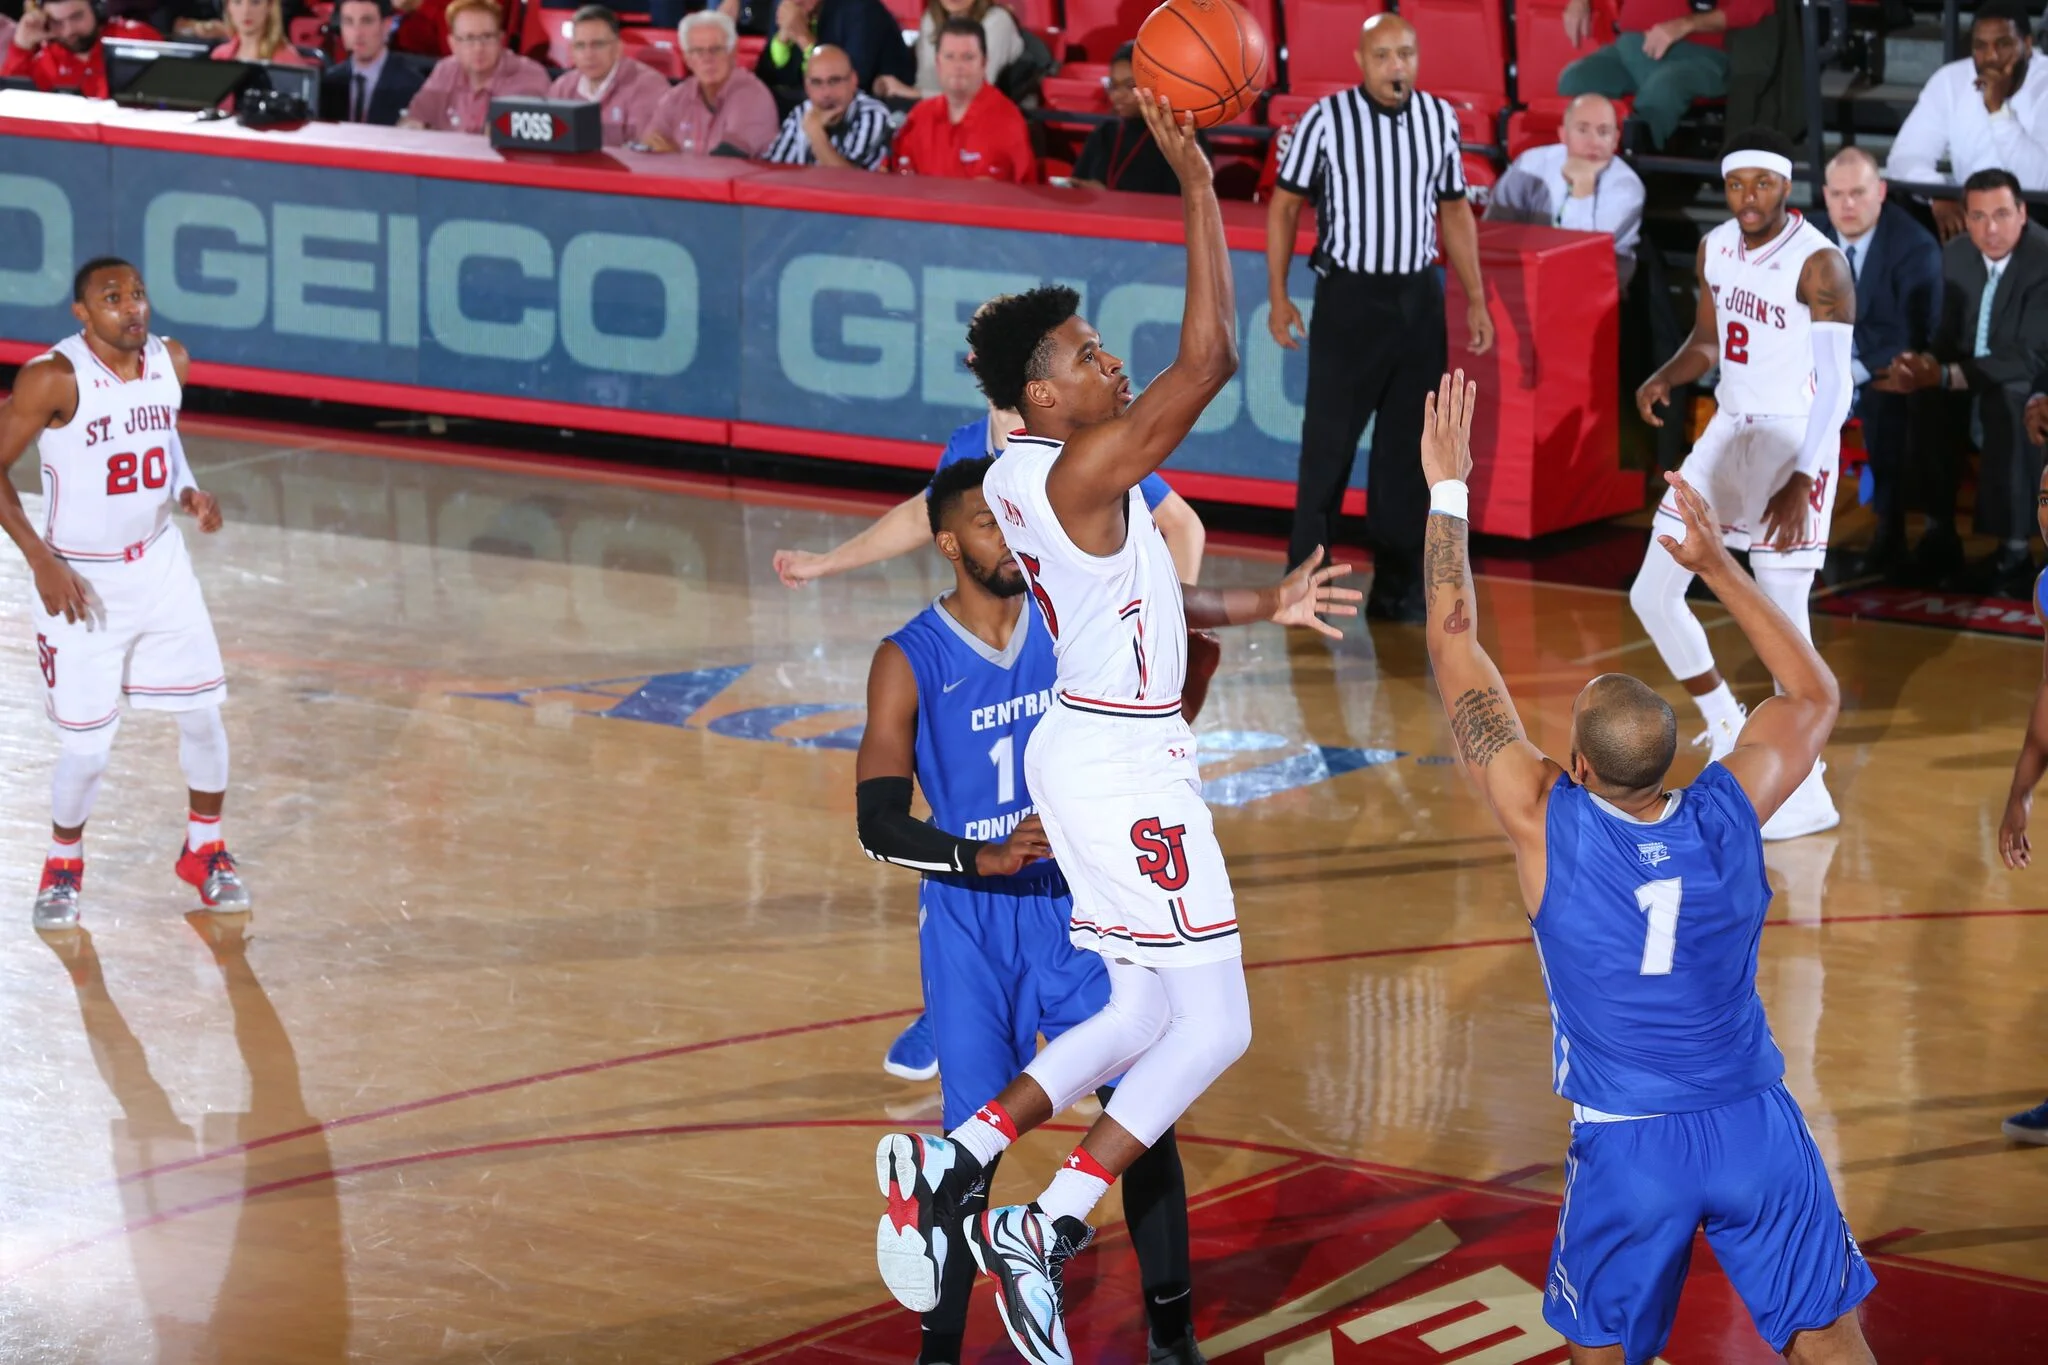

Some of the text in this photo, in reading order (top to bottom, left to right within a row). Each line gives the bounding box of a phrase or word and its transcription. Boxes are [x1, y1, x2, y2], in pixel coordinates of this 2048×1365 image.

[510, 111, 553, 141] POSS
[143, 190, 699, 377] GEICO
[1725, 287, 1786, 330] JOHN'S
[1724, 320, 1749, 365] 2
[86, 414, 115, 446] ST.
[106, 446, 167, 496] 20
[1130, 816, 1189, 891] SJ
[1634, 876, 1682, 975] 1
